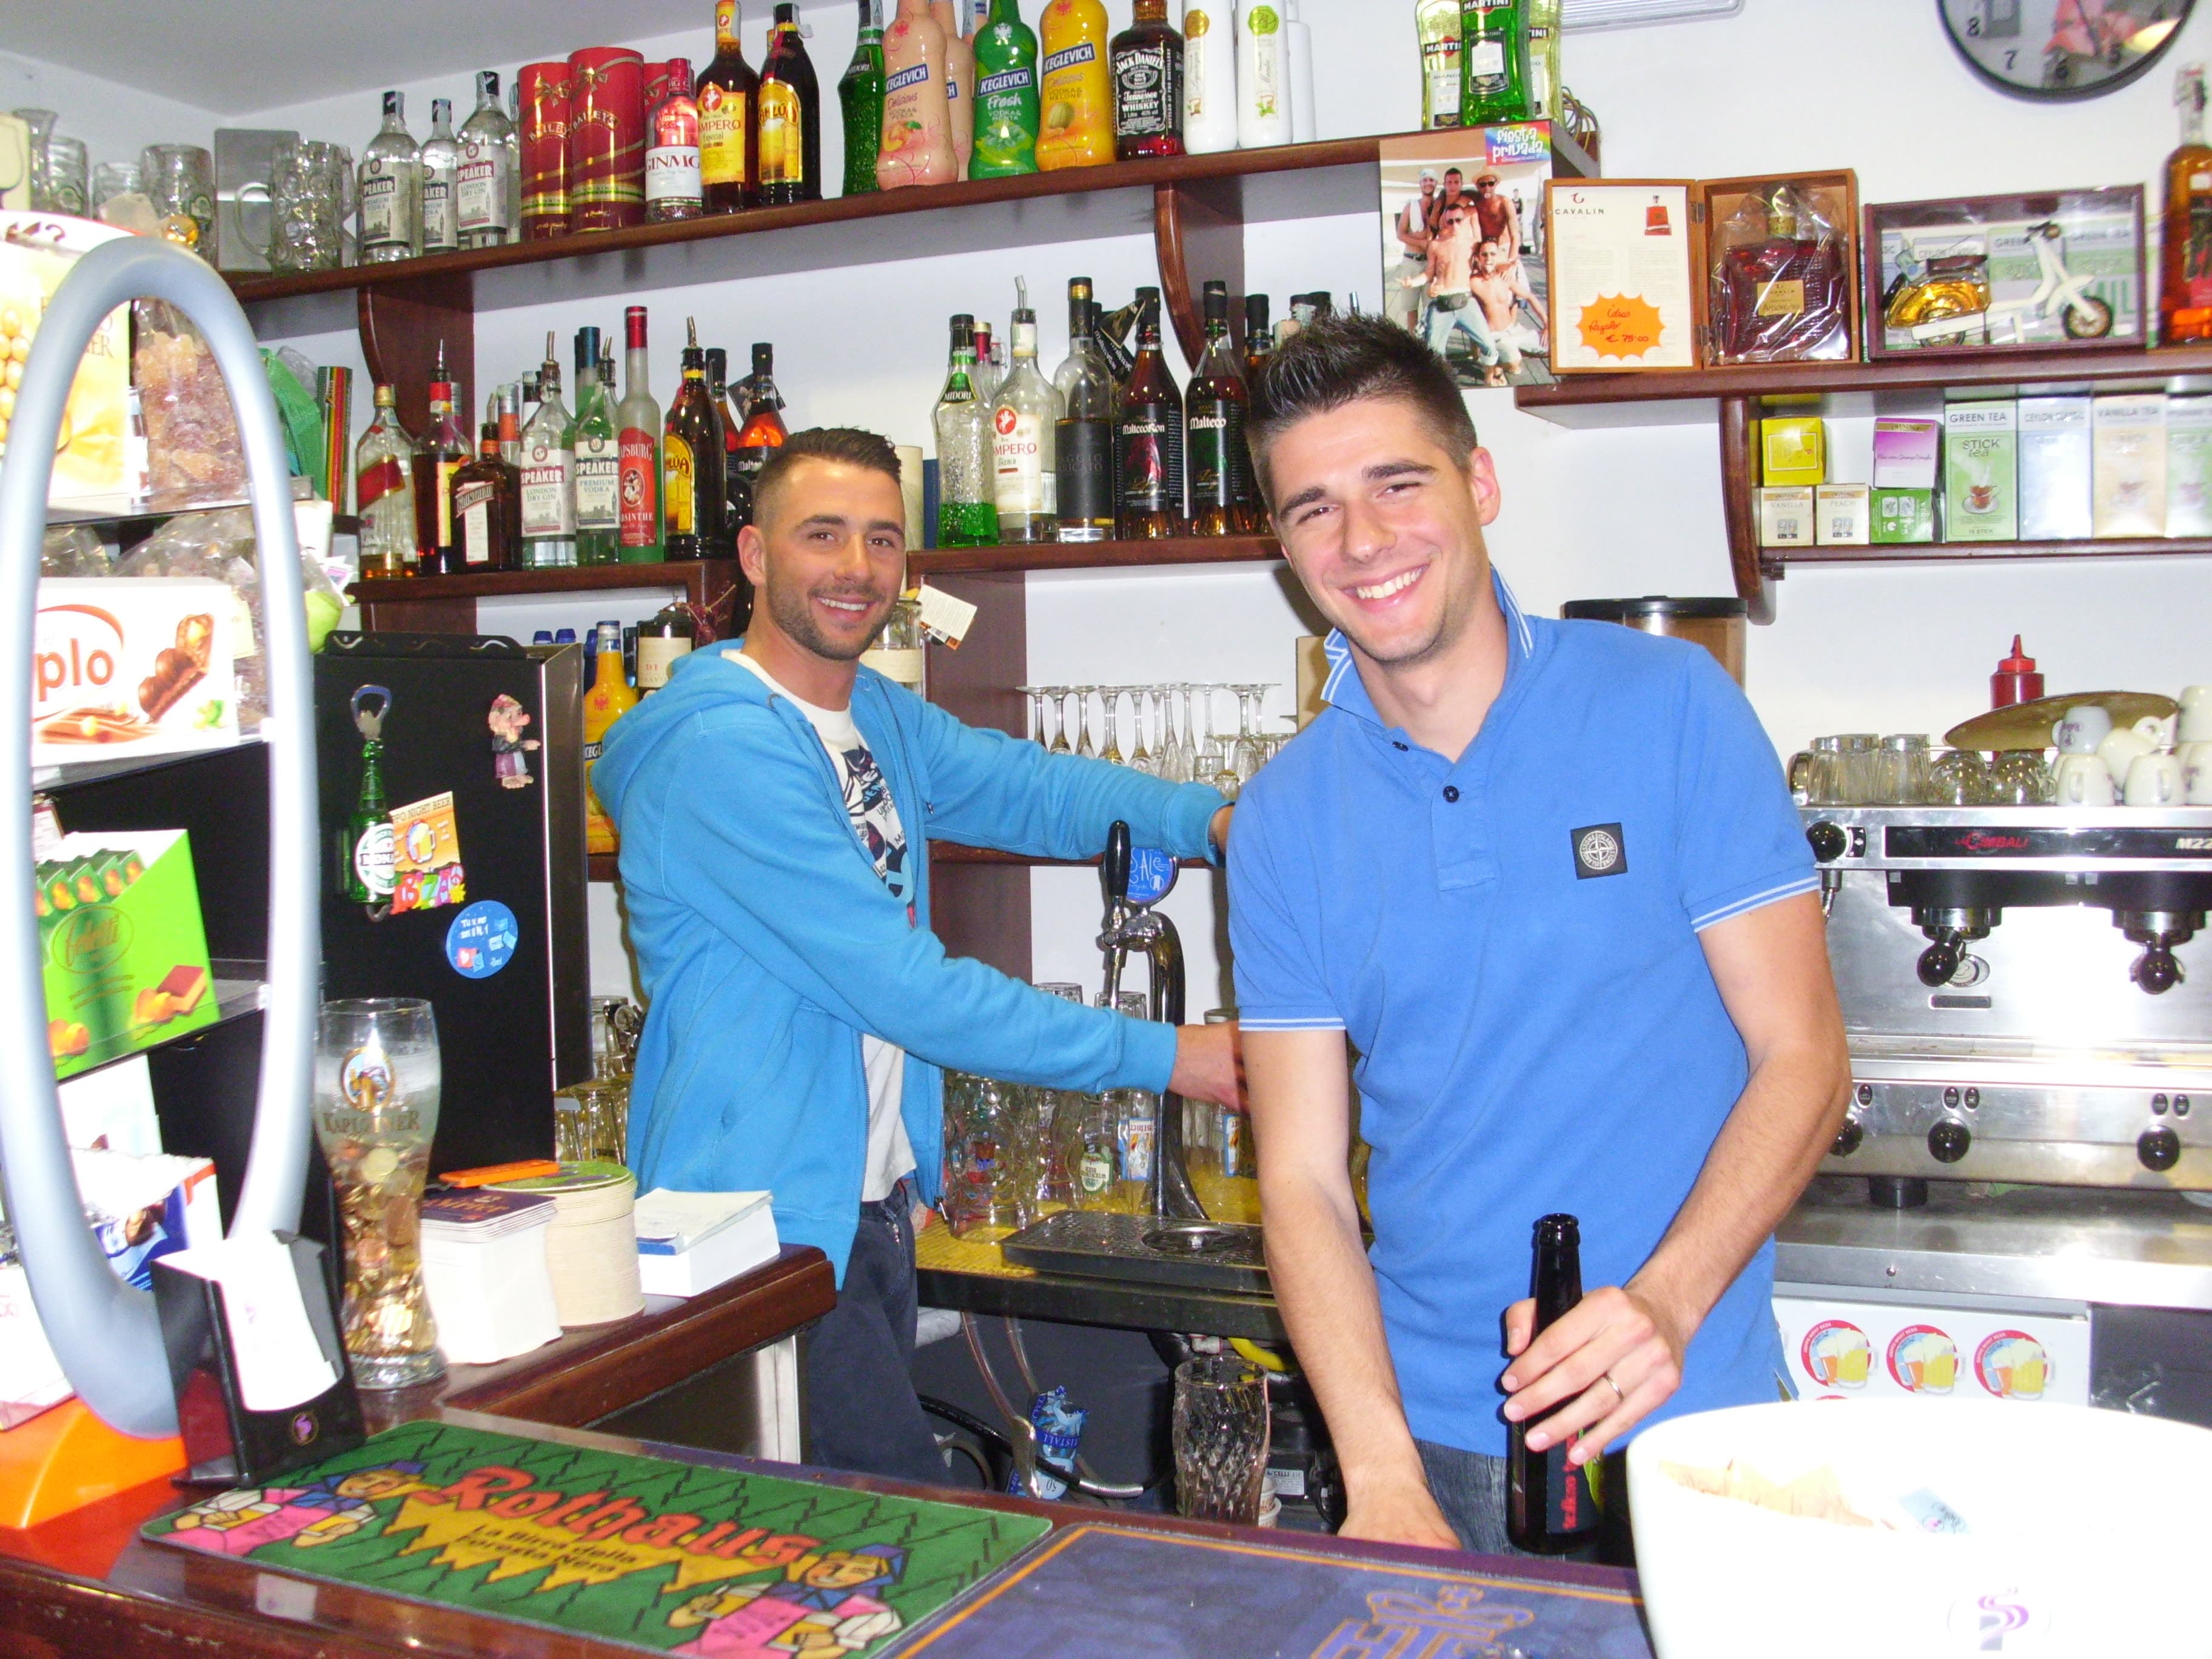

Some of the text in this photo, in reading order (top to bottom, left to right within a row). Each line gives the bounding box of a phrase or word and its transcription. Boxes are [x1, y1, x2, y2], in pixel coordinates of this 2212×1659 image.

[1464, 0, 1510, 12] MARTINI
[1529, 29, 1547, 38] TINI
[1426, 41, 1461, 53] MARTI
[1116, 56, 1135, 75] JACK
[886, 66, 927, 92] KEGLEVICH
[980, 70, 1029, 94] KEGLEVICH
[987, 93, 1022, 110] Fresh
[1122, 101, 1159, 112] WHISKEY
[529, 121, 571, 141] BAILEY
[699, 119, 741, 132] AMPERO
[1496, 126, 1537, 144] fiesta
[1492, 140, 1543, 163] privada
[364, 179, 394, 196] PEAKER
[424, 186, 447, 198] AKER
[1949, 412, 2006, 423] GREEN TEA
[993, 443, 1037, 457] AMPERO
[1963, 438, 1999, 451] STICK
[620, 443, 652, 461] PSBURG
[1968, 447, 1989, 458] tea
[577, 461, 618, 475] SPEAKER
[521, 469, 564, 484] SPEAKER
[580, 478, 615, 487] PREMIUM
[526, 488, 557, 496] LONDON
[622, 512, 654, 521] SINTHE
[36, 637, 115, 702] plo
[408, 803, 431, 819] NIGHT
[432, 797, 452, 811] BEER
[412, 1465, 823, 1566] Rothaus
[506, 1530, 568, 1549] Birra
